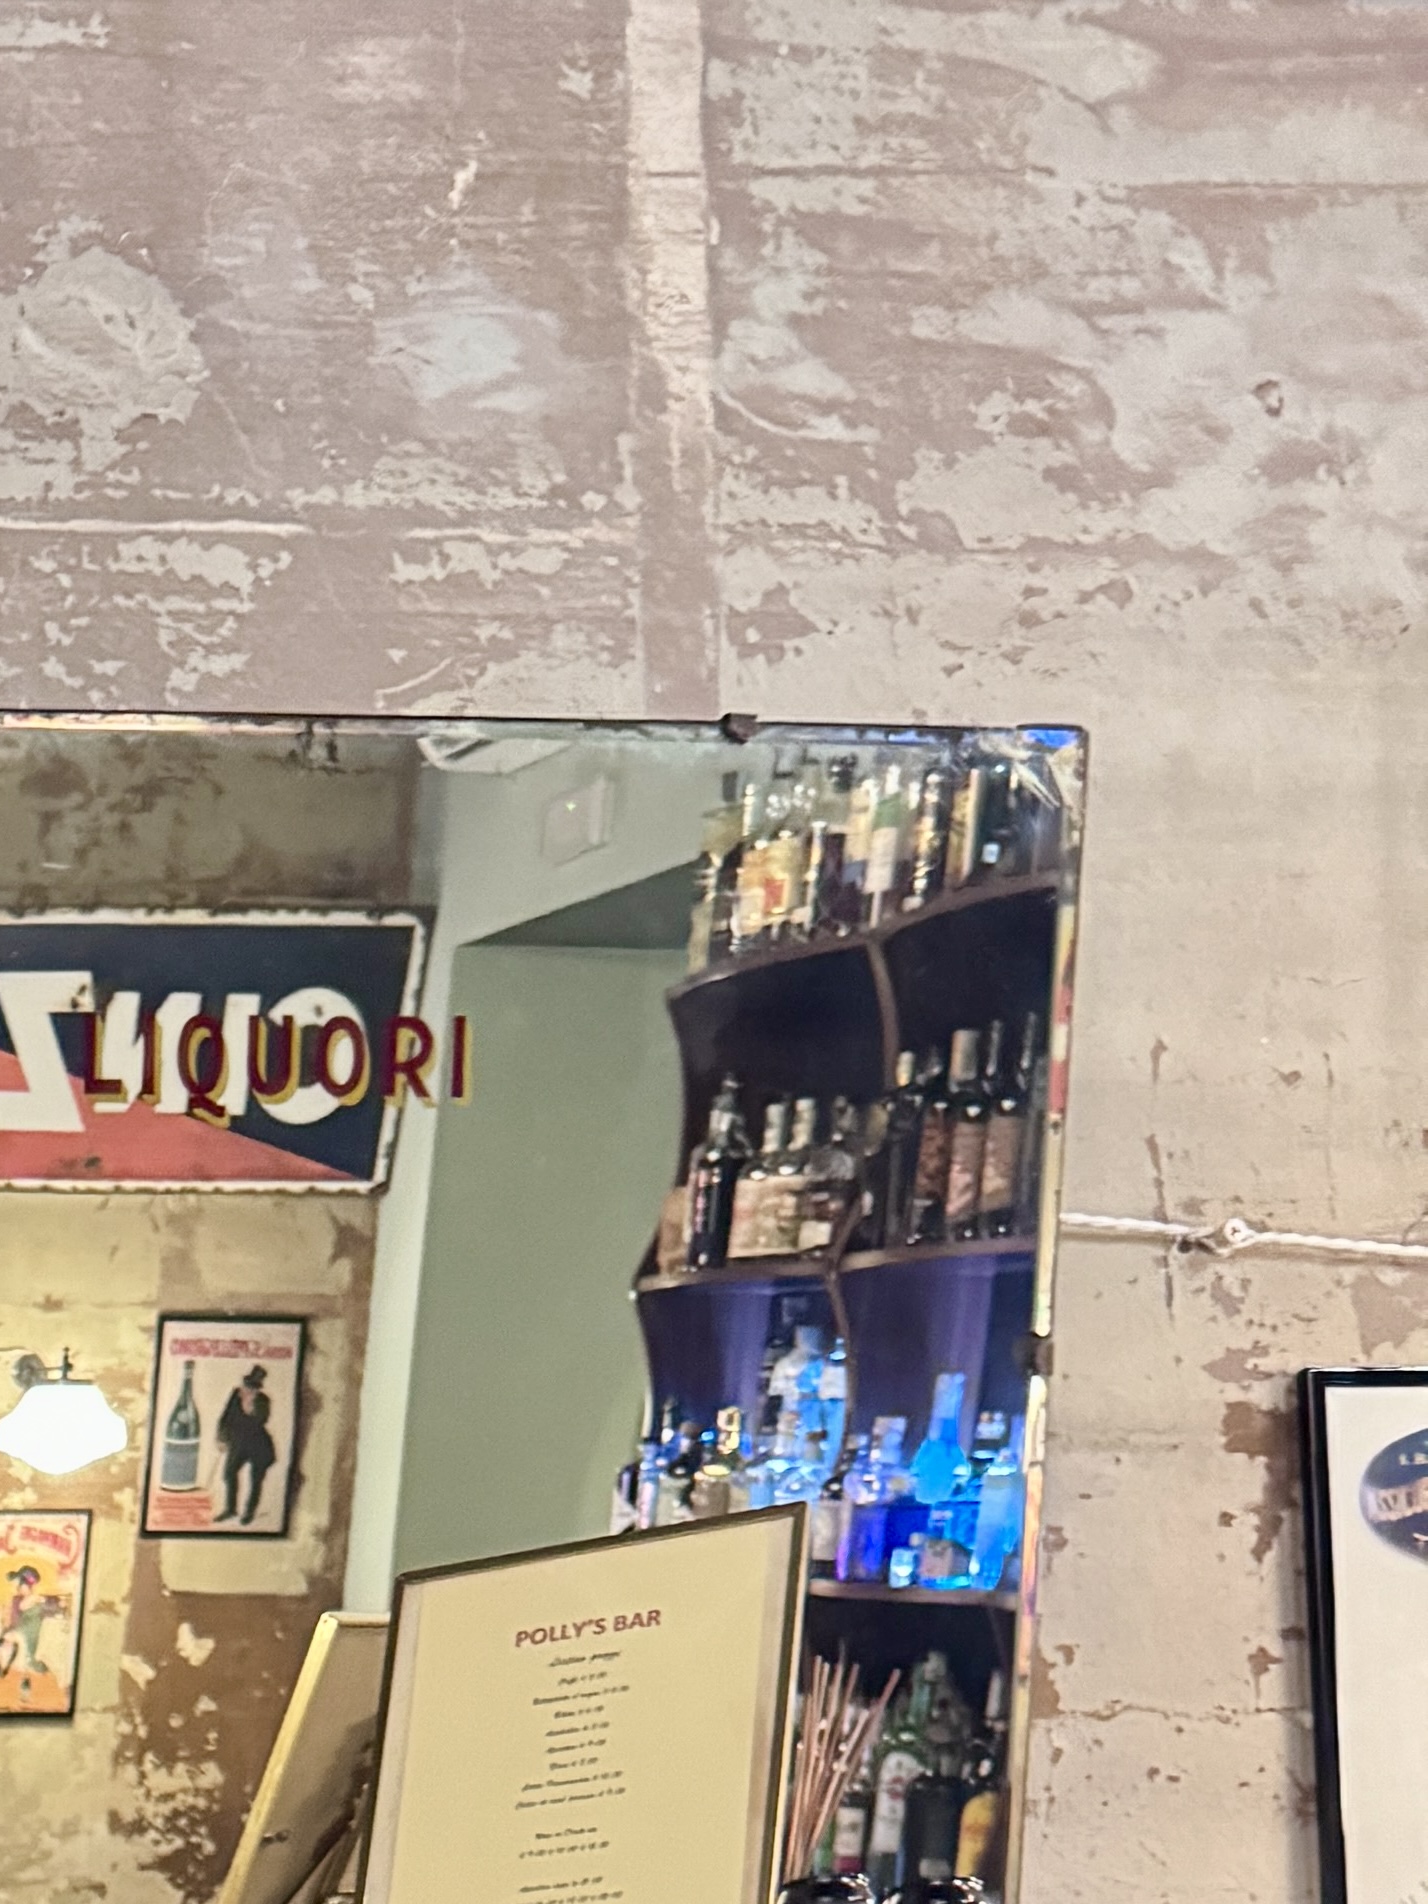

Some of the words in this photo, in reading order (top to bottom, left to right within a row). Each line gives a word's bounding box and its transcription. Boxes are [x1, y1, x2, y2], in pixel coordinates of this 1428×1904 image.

[83, 1013, 473, 1128] LIQUORI
[514, 1617, 607, 1648] POLLY'S
[612, 1608, 662, 1632] BAR
